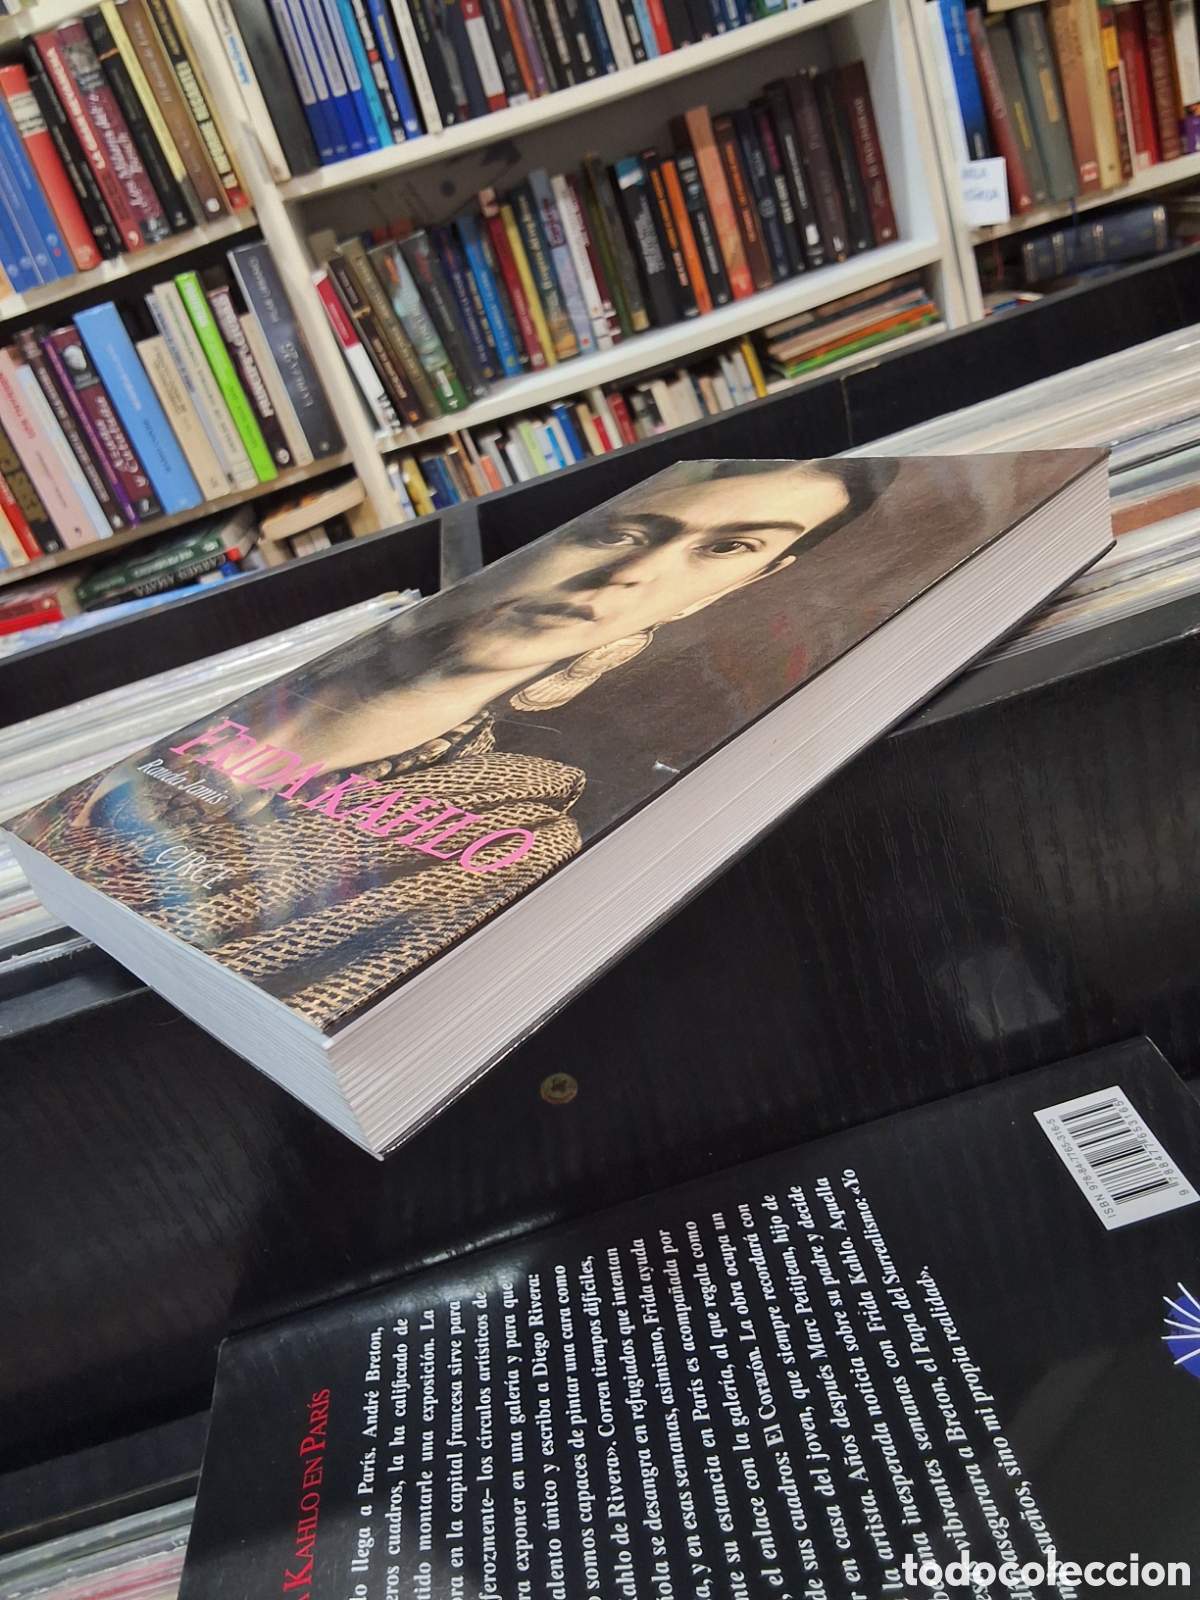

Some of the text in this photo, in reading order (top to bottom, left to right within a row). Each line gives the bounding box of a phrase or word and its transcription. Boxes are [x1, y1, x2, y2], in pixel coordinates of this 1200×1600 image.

[137, 758, 229, 804] Rauda Jamis
[170, 719, 535, 872] FRIDA KAHLO
[155, 845, 237, 890] CIRCE
[1046, 1118, 1117, 1219] ISBN 978-84-7765-316-5
[711, 1211, 727, 1231] un
[786, 1185, 816, 1230] decide
[717, 1233, 740, 1278] ocupa
[809, 1244, 842, 1287] padre
[418, 1308, 436, 1332] La
[471, 1290, 489, 1310] de
[526, 1272, 545, 1328] Rivera:
[728, 1279, 750, 1316] obra
[738, 1318, 758, 1343] La
[826, 1289, 844, 1308] su
[833, 1310, 860, 1353] sobre
[418, 1337, 440, 1423] exposición.
[473, 1313, 492, 1383] artísticos
[530, 1331, 551, 1378] Diego
[745, 1345, 777, 1421] Corazón.
[813, 1176, 972, 1551] vibrantes semanas con Frida Kahlo. Aquella
[840, 1168, 1018, 1562] asegurara Breton, el Papa del Surrealismo: «Yo
[474, 1386, 494, 1450] círculos
[577, 1254, 631, 1546] de Rivera». Corren tiempos difíciles,
[606, 1246, 668, 1557] se desangra en refugiados que intentan
[629, 1237, 704, 1559] en esas semanas, asimismo, Frida ayuda
[658, 1229, 742, 1564] su estancia en París es acompañada por
[684, 1220, 785, 1587] el enlace con la galería, al que regala como
[736, 1202, 862, 1583] en casa del joven, que siempre recordará con
[760, 1194, 905, 1591] la artista. Años después Marc Petitjean, hijo de
[848, 1355, 884, 1417] noticia
[915, 1264, 1057, 1556] sueños, sino mi propia realidad».
[350, 1325, 386, 1573] llega París. André Breton,
[383, 1317, 412, 1556] cuadros, la ha calificado de
[421, 1429, 435, 1463] una
[444, 1300, 469, 1569] en la capital francesa sirve para
[501, 1282, 535, 1572] exponer en una galería para que
[533, 1397, 555, 1457] escriba
[553, 1264, 601, 1591] somos capaces de pintar una cara como
[762, 1422, 785, 1448] El
[283, 1388, 331, 1592] KAHLO EN PARÍS
[475, 1455, 495, 1482] los
[774, 1450, 809, 1532] cuadros:
[870, 1421, 923, 1526] inesperada
[415, 1469, 434, 1552] montarle
[540, 1479, 561, 1532] único
[797, 1537, 820, 1572] sus
